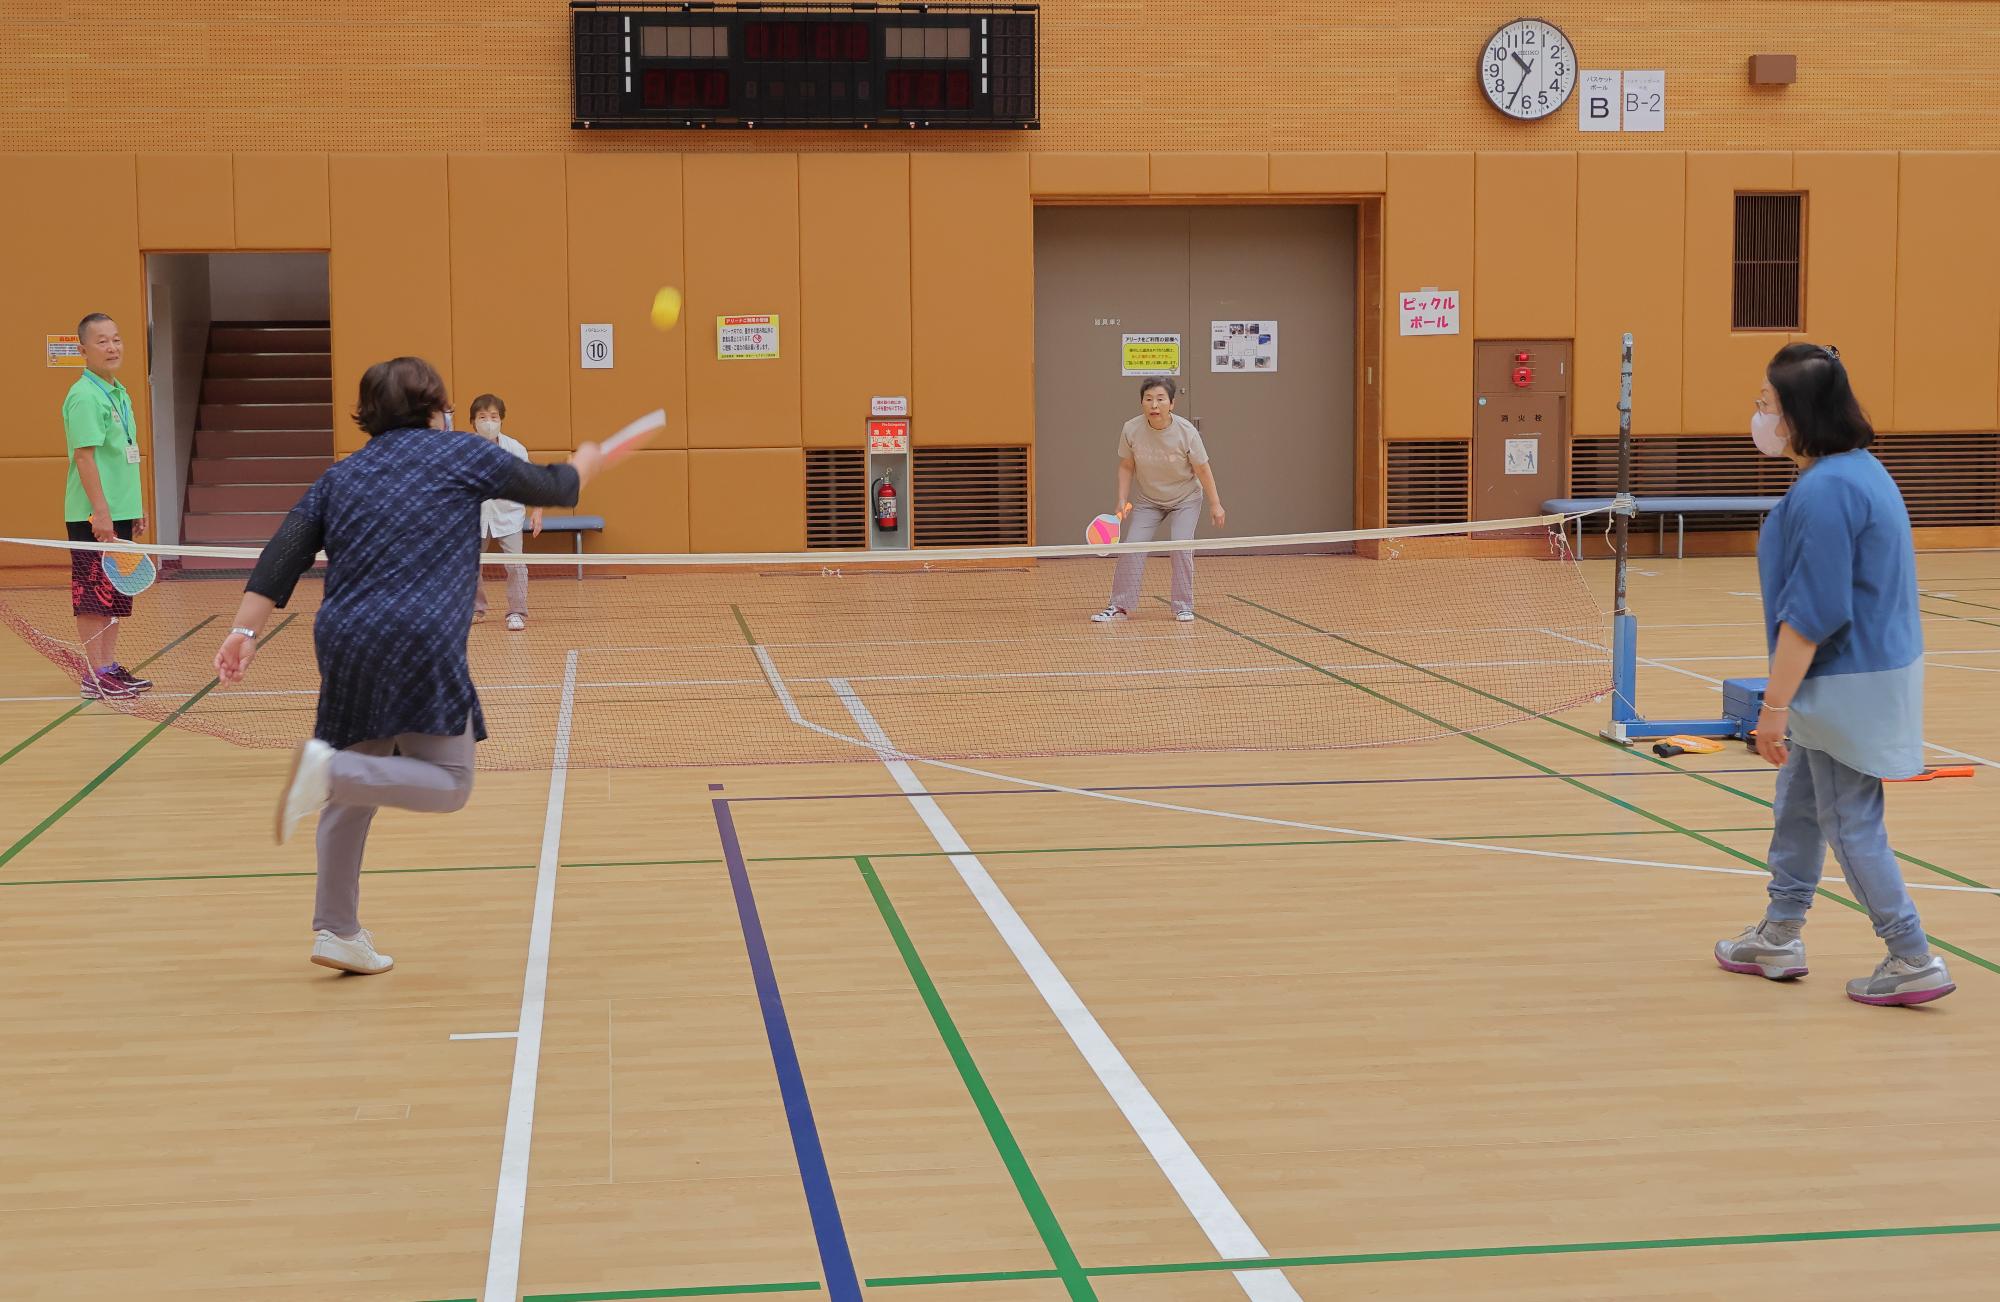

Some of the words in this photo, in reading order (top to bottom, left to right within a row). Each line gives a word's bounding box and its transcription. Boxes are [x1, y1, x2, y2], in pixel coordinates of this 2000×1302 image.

[1507, 34, 1518, 48] 11
[1521, 30, 1535, 45] 12
[1493, 46, 1508, 61] 10
[1550, 45, 1560, 59] 2
[1489, 63, 1500, 78] 9
[1554, 62, 1565, 76] 3
[1494, 78, 1505, 93] 8
[1549, 78, 1560, 92] 4
[1586, 75, 1613, 83] バスケット
[1521, 95, 1532, 109] 6
[1537, 91, 1548, 105] 5
[1626, 93, 1661, 112] B-2
[1590, 97, 1610, 118] B
[1403, 297, 1456, 310] ピックル
[1410, 315, 1448, 328] ボール
